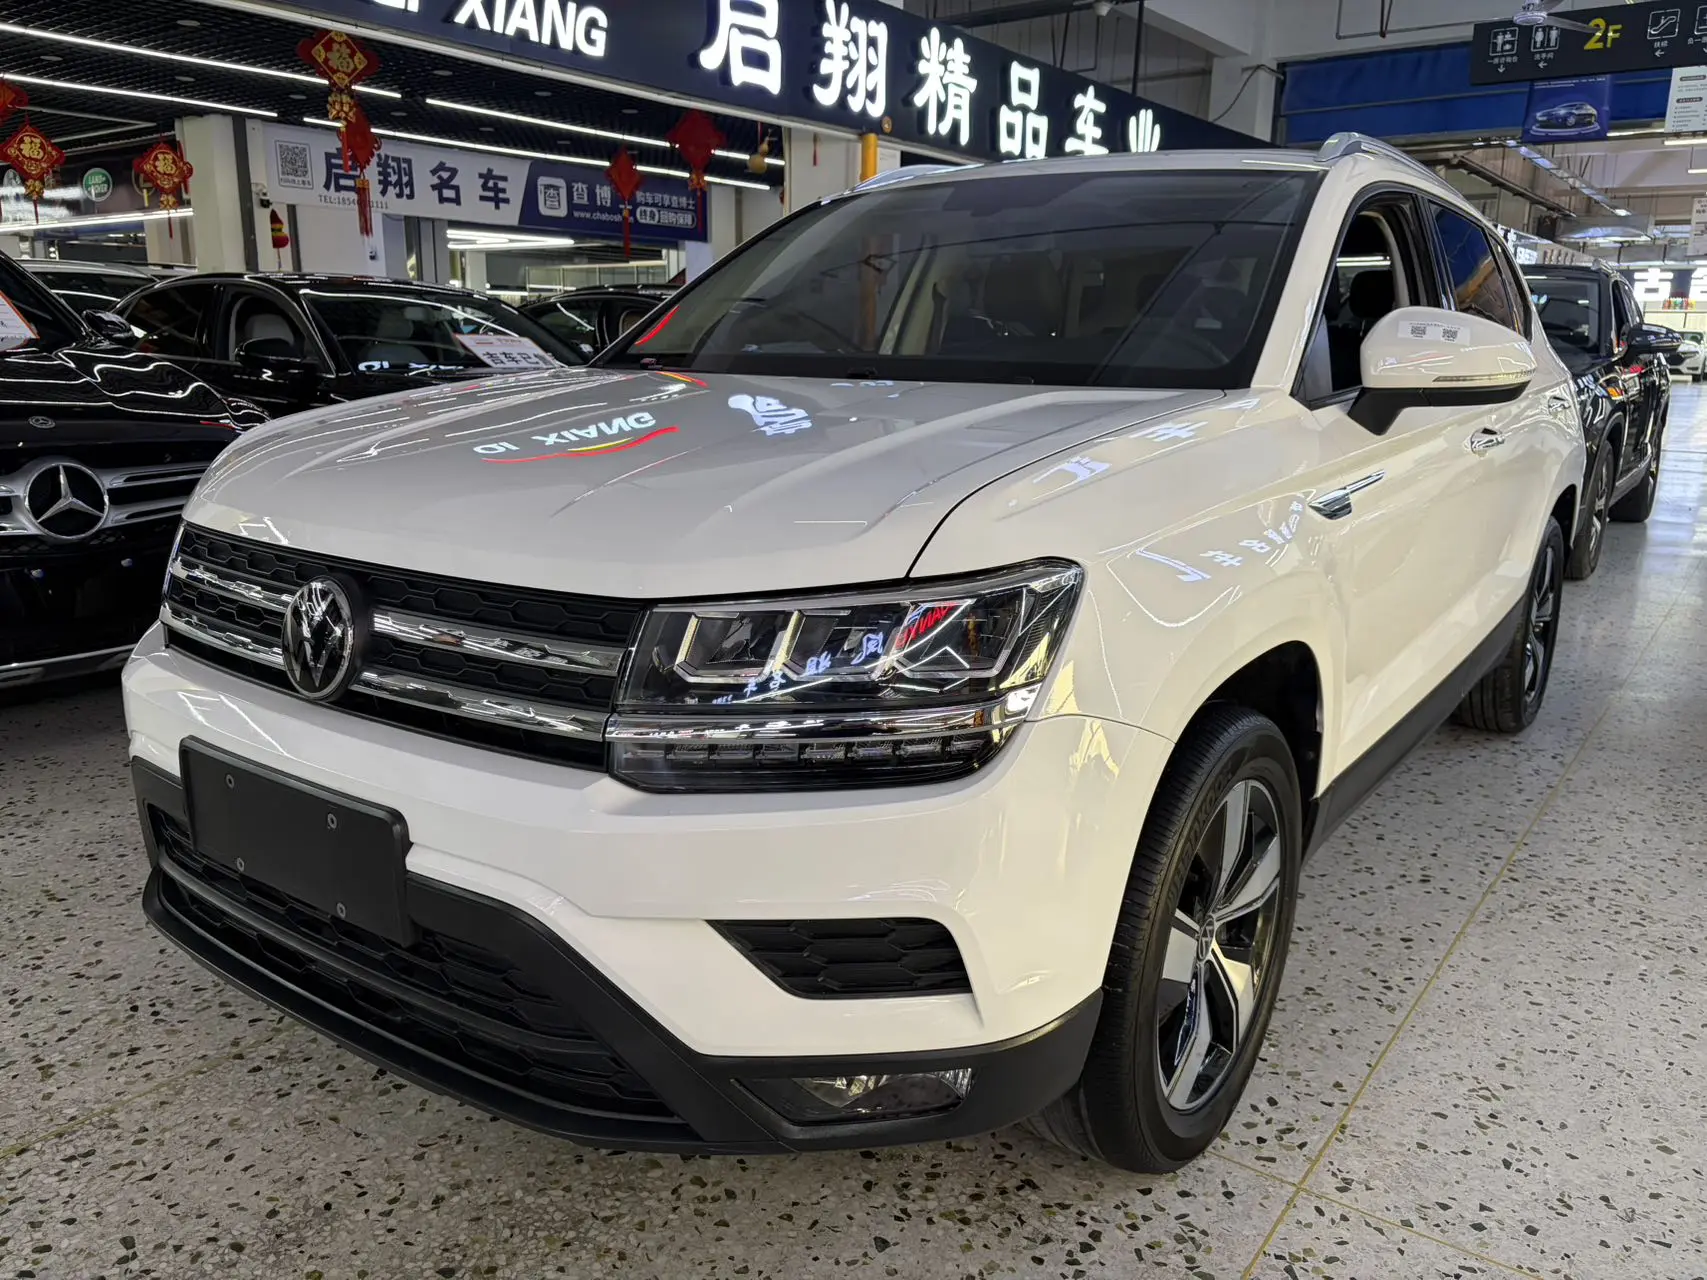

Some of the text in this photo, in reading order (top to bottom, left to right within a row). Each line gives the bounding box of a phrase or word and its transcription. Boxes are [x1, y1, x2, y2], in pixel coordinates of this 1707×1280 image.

[453, 0, 608, 57] XIANG
[1584, 18, 1622, 50] 2F
[322, 145, 512, 211] 启翔名车
[572, 182, 633, 210] 查博
